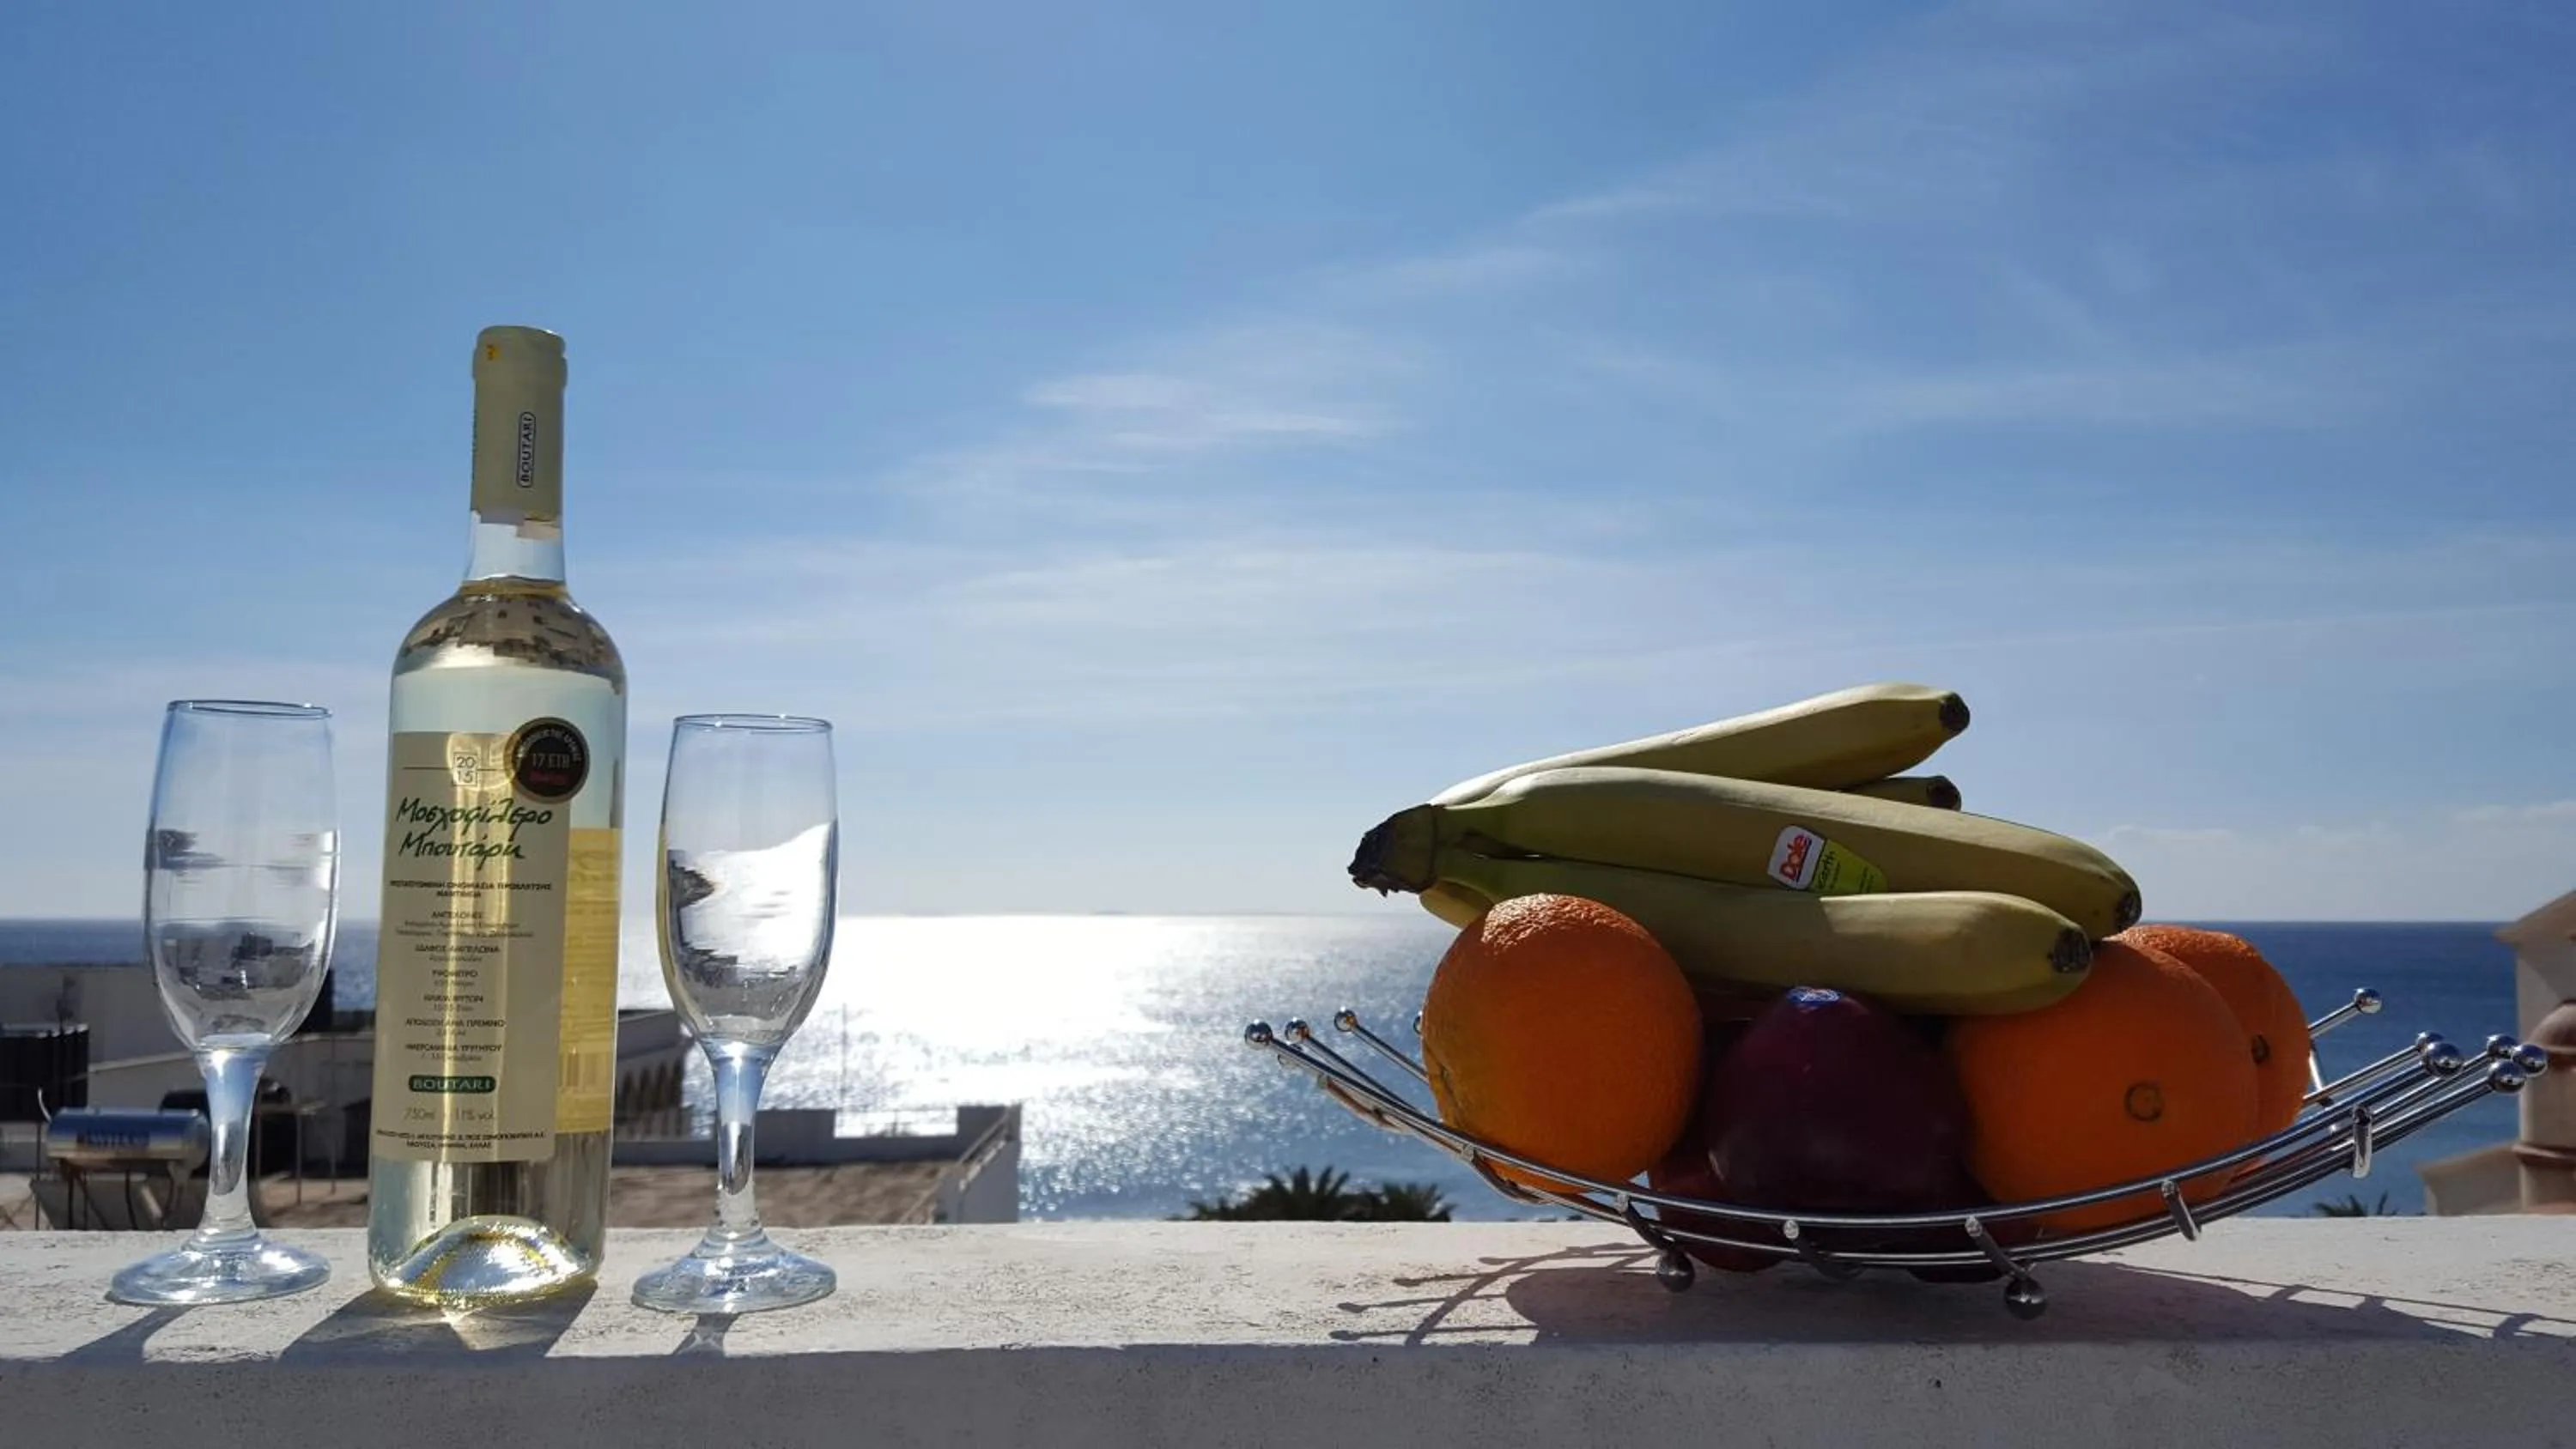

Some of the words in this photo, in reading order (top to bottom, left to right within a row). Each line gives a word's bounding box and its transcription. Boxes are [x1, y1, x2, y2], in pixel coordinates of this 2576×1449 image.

[520, 415, 533, 482] BOUTARI
[456, 756, 475, 768] 20
[532, 753, 544, 768] 17
[457, 772, 474, 784] 15
[1779, 834, 1808, 881] Dole
[412, 1077, 491, 1090] BOUTARI
